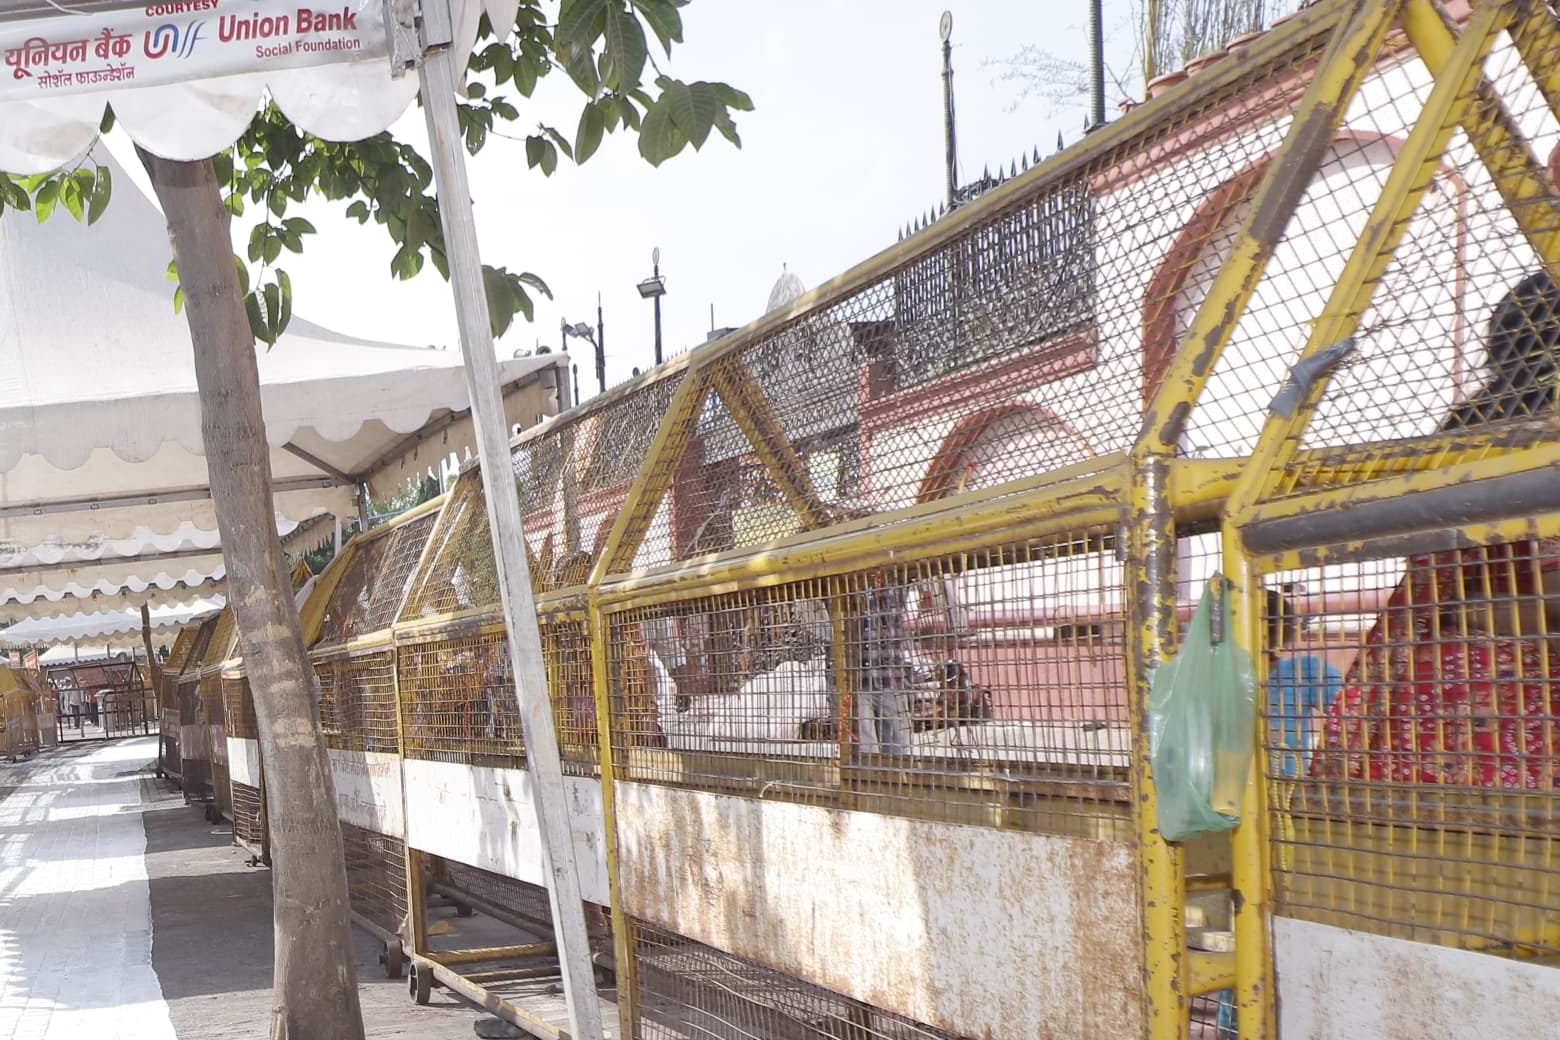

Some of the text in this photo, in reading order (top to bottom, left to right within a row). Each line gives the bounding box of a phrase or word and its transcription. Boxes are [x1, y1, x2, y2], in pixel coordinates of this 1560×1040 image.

[145, 0, 218, 16] COURTESY
[218, 6, 357, 42] Union Bank
[4, 28, 133, 80] यूनियन बैंक
[255, 38, 360, 58] Social Foundation
